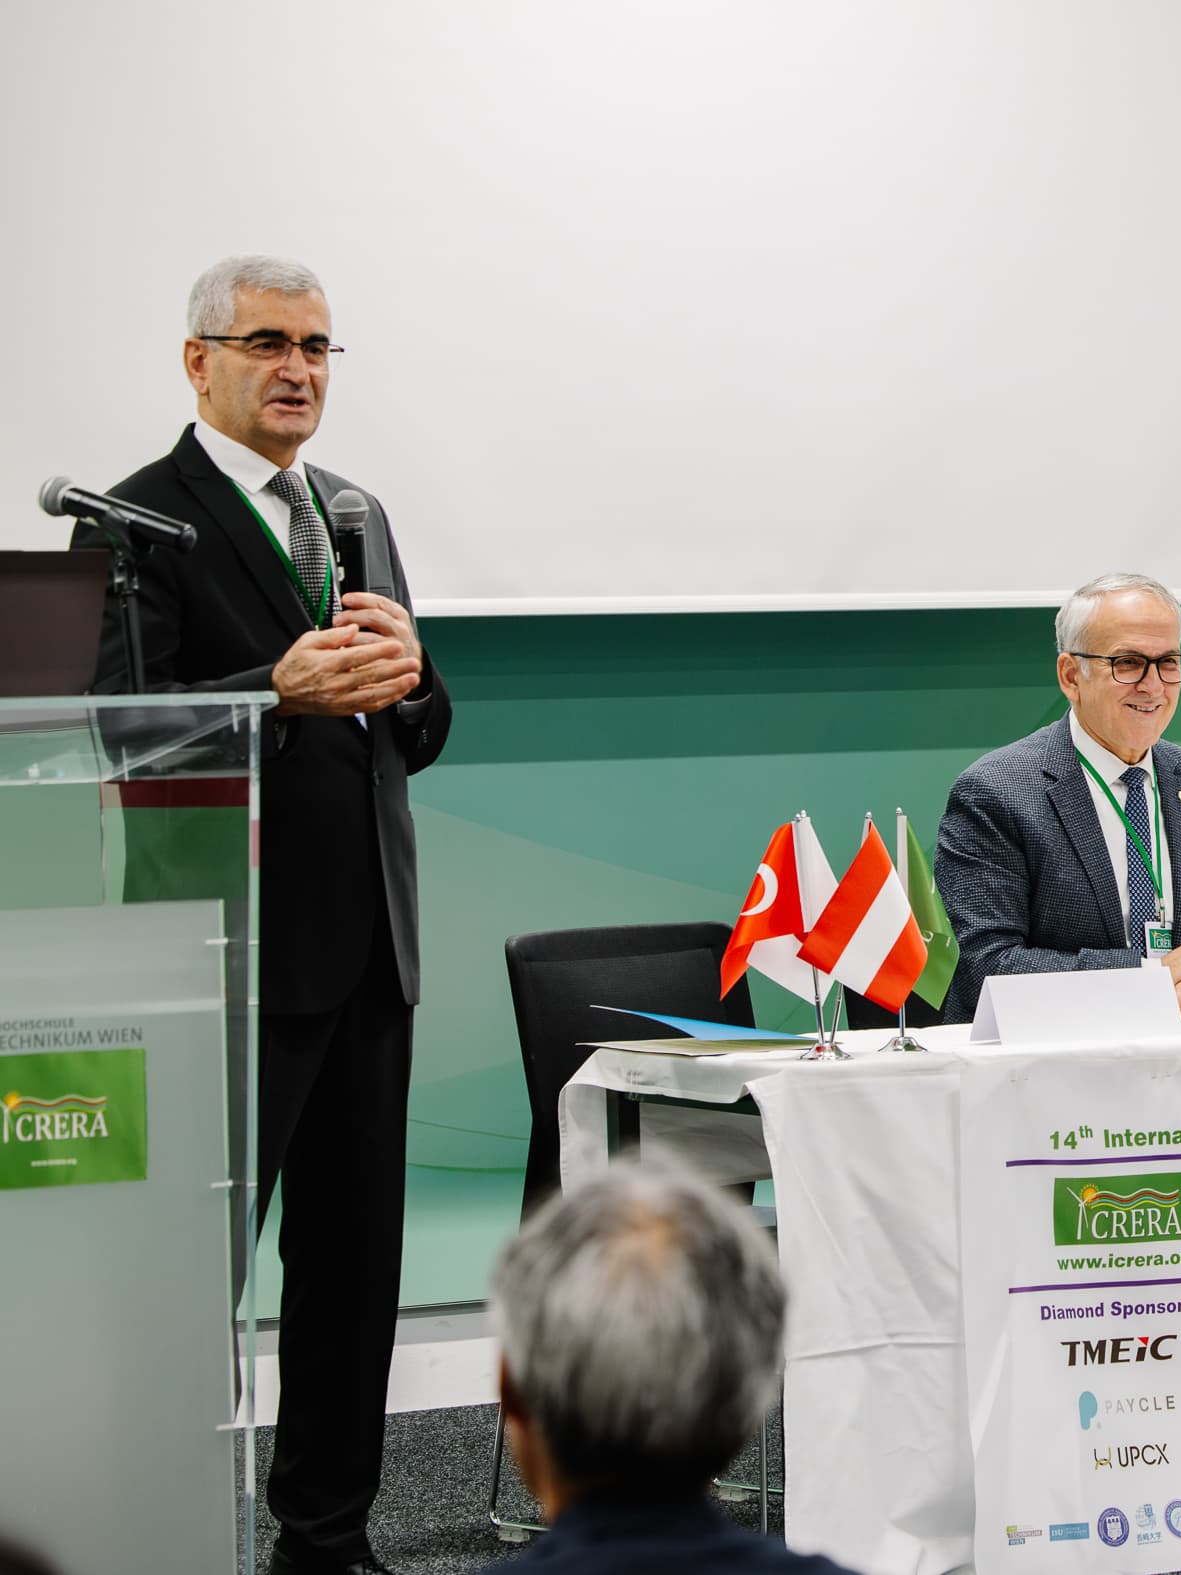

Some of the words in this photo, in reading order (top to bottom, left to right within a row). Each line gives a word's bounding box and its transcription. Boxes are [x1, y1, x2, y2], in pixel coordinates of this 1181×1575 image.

[97, 1027, 143, 1043] WIEN
[1049, 1125, 1093, 1150] 14th
[1040, 1302, 1104, 1320] Diamond
[1105, 1395, 1176, 1414] PAYCLE
[1117, 1443, 1170, 1468] UPCX
